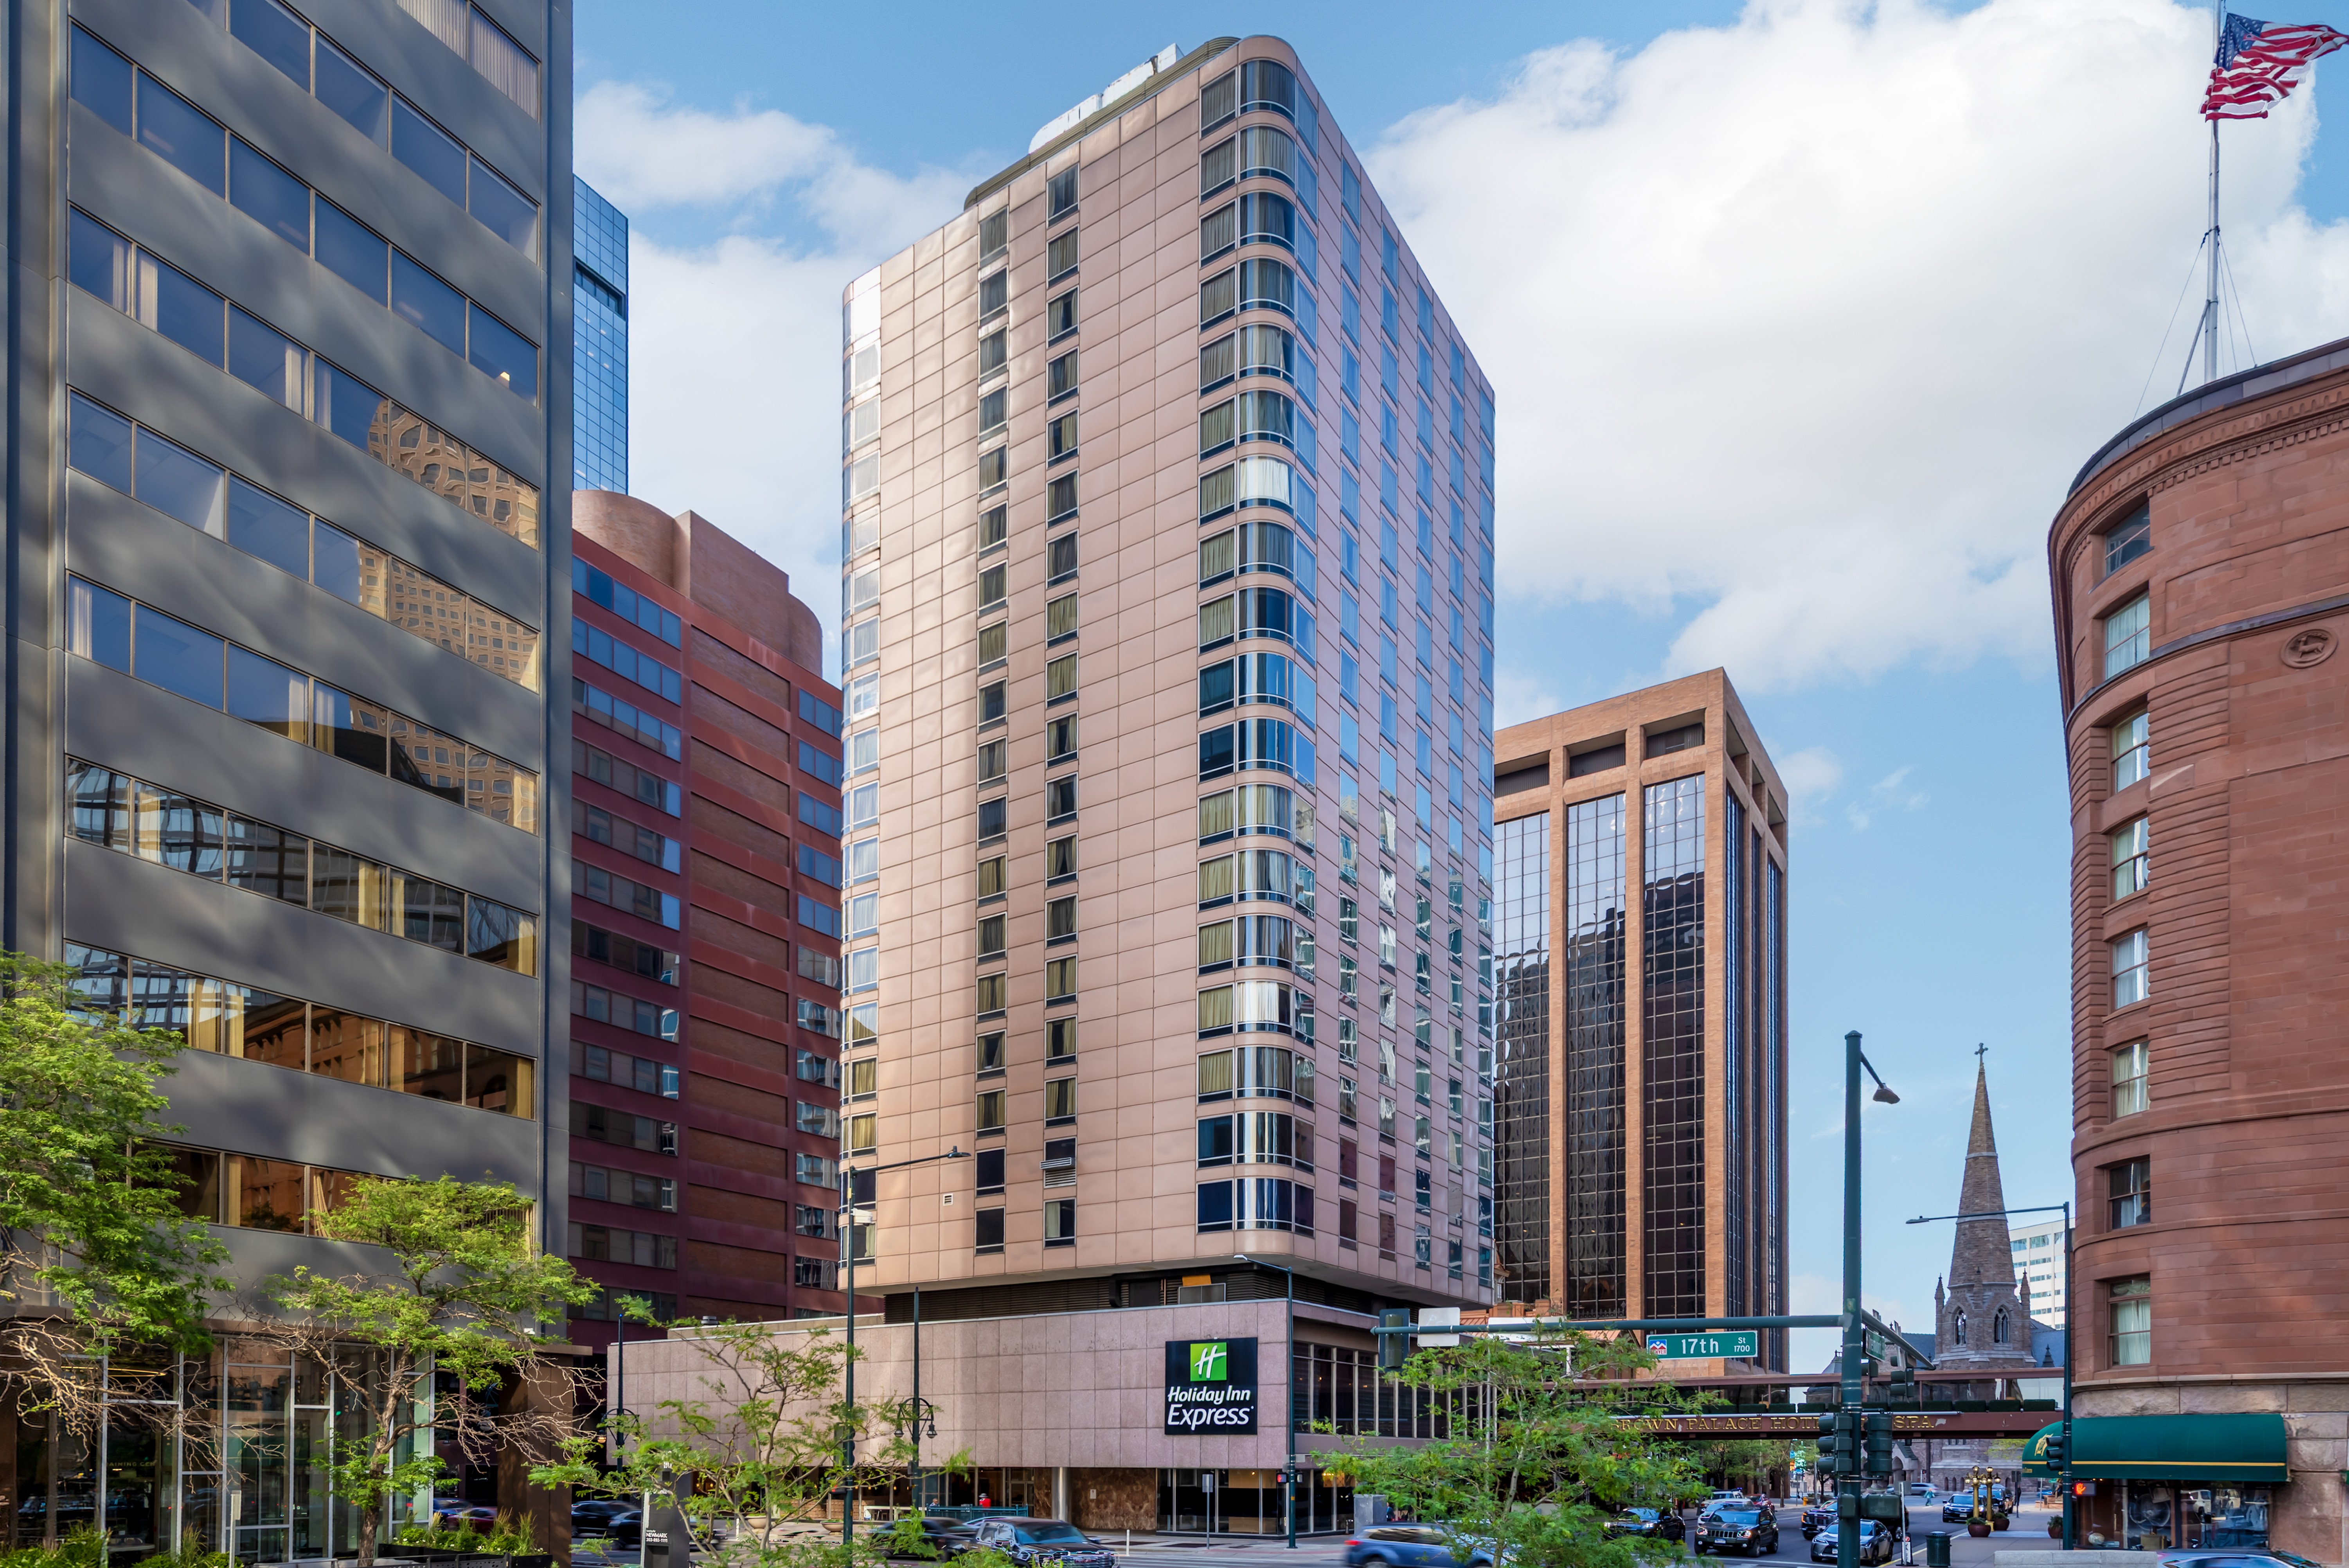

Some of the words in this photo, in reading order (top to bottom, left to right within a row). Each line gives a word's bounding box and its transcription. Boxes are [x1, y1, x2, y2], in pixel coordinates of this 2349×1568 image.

[1682, 1338, 1719, 1354] 17th
[1167, 1386, 1225, 1405] Holiday
[1226, 1385, 1251, 1401] Inn
[1167, 1404, 1250, 1431] Express
[1686, 1417, 1762, 1430] PALACE
[1770, 1417, 1819, 1429] HOT
[1894, 1415, 1934, 1428] SPA
